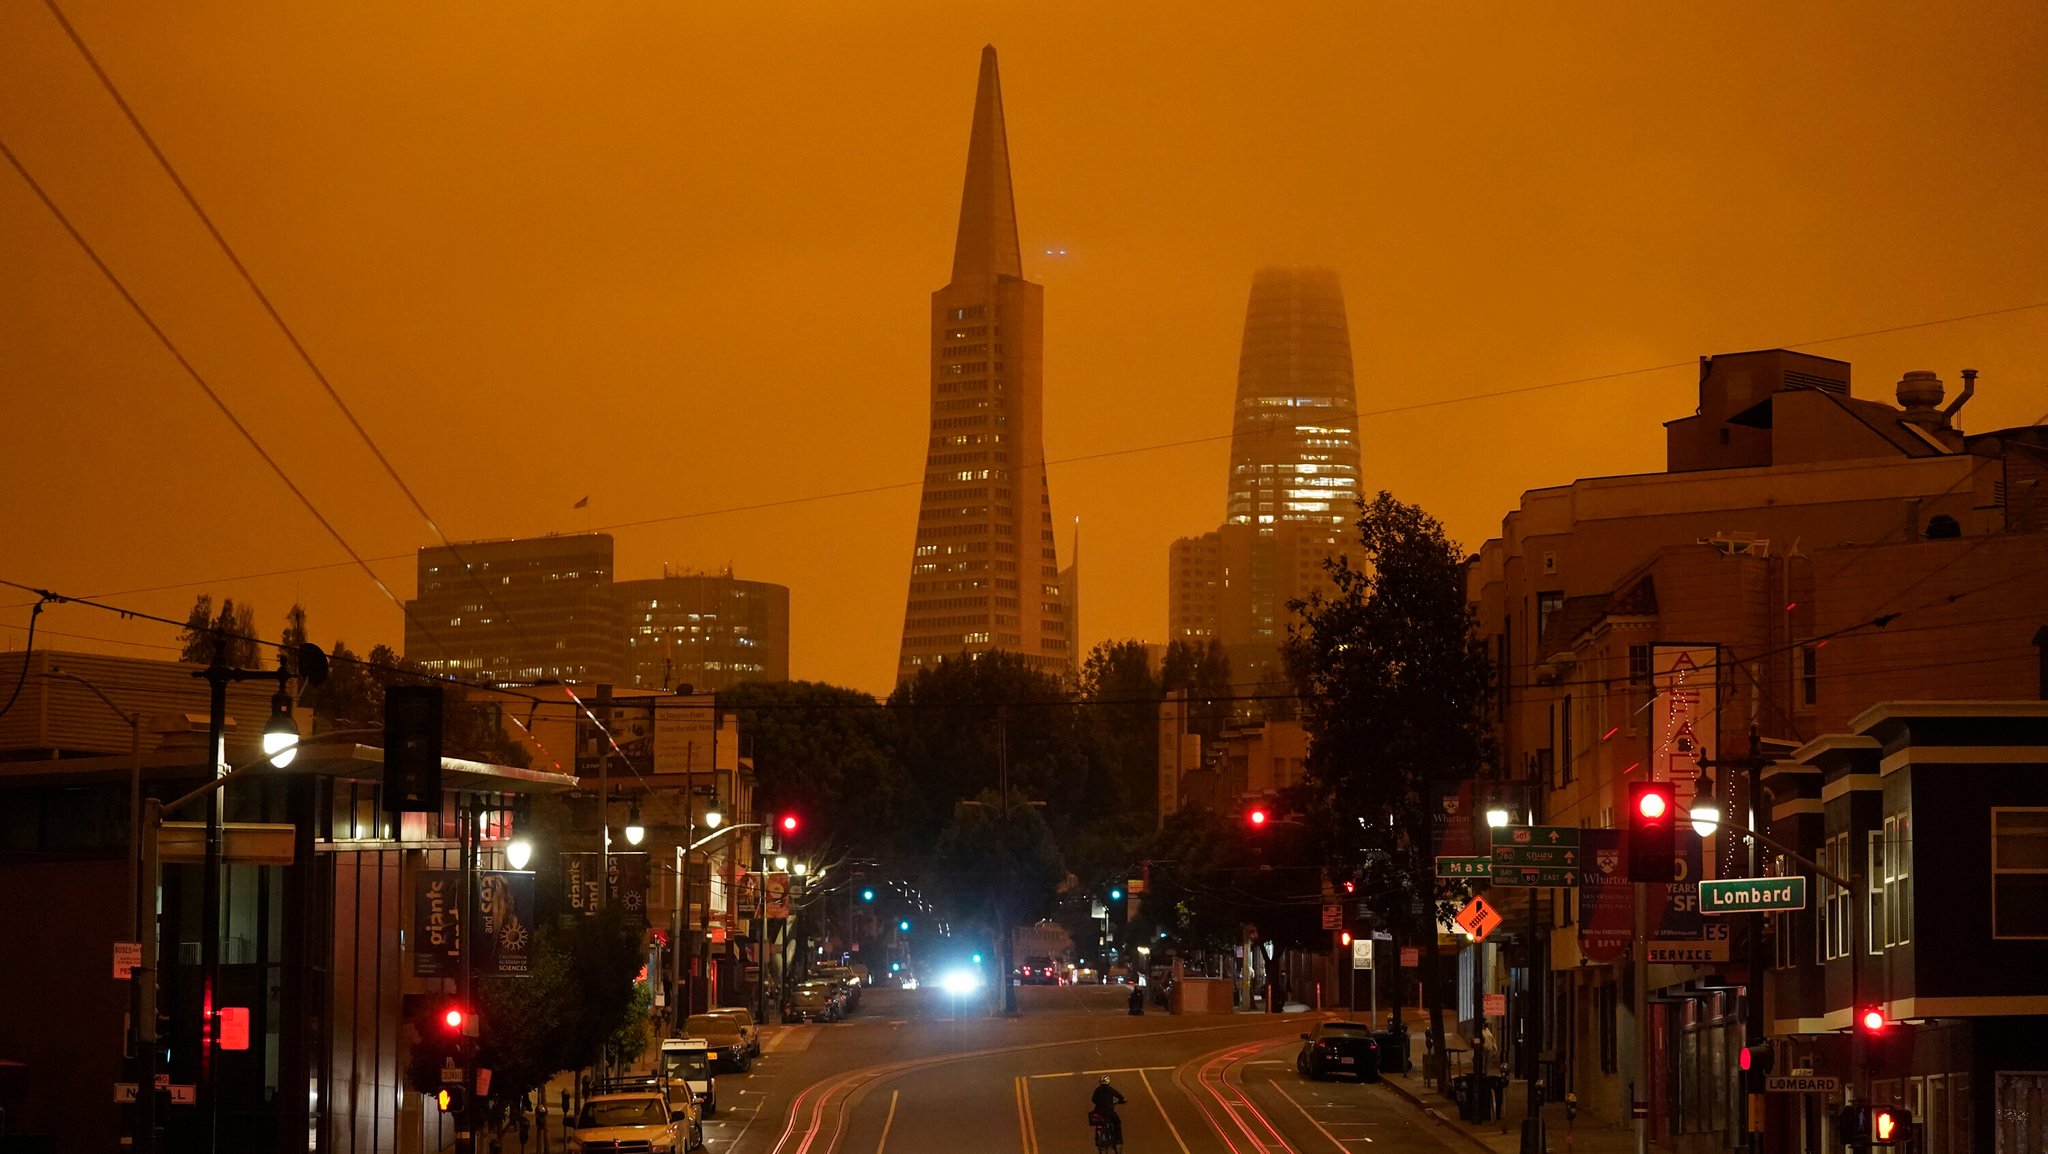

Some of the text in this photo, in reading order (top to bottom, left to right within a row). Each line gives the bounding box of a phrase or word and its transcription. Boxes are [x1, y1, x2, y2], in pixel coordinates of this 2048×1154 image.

[568, 860, 584, 908] giants
[1666, 883, 1696, 893] YEARS
[481, 876, 494, 913] sea
[1673, 895, 1696, 912] SF
[1713, 885, 1791, 905] Lombard
[482, 915, 493, 934] and
[1651, 950, 1712, 960] SERVICE
[1770, 1079, 1835, 1090] LOMBARD
